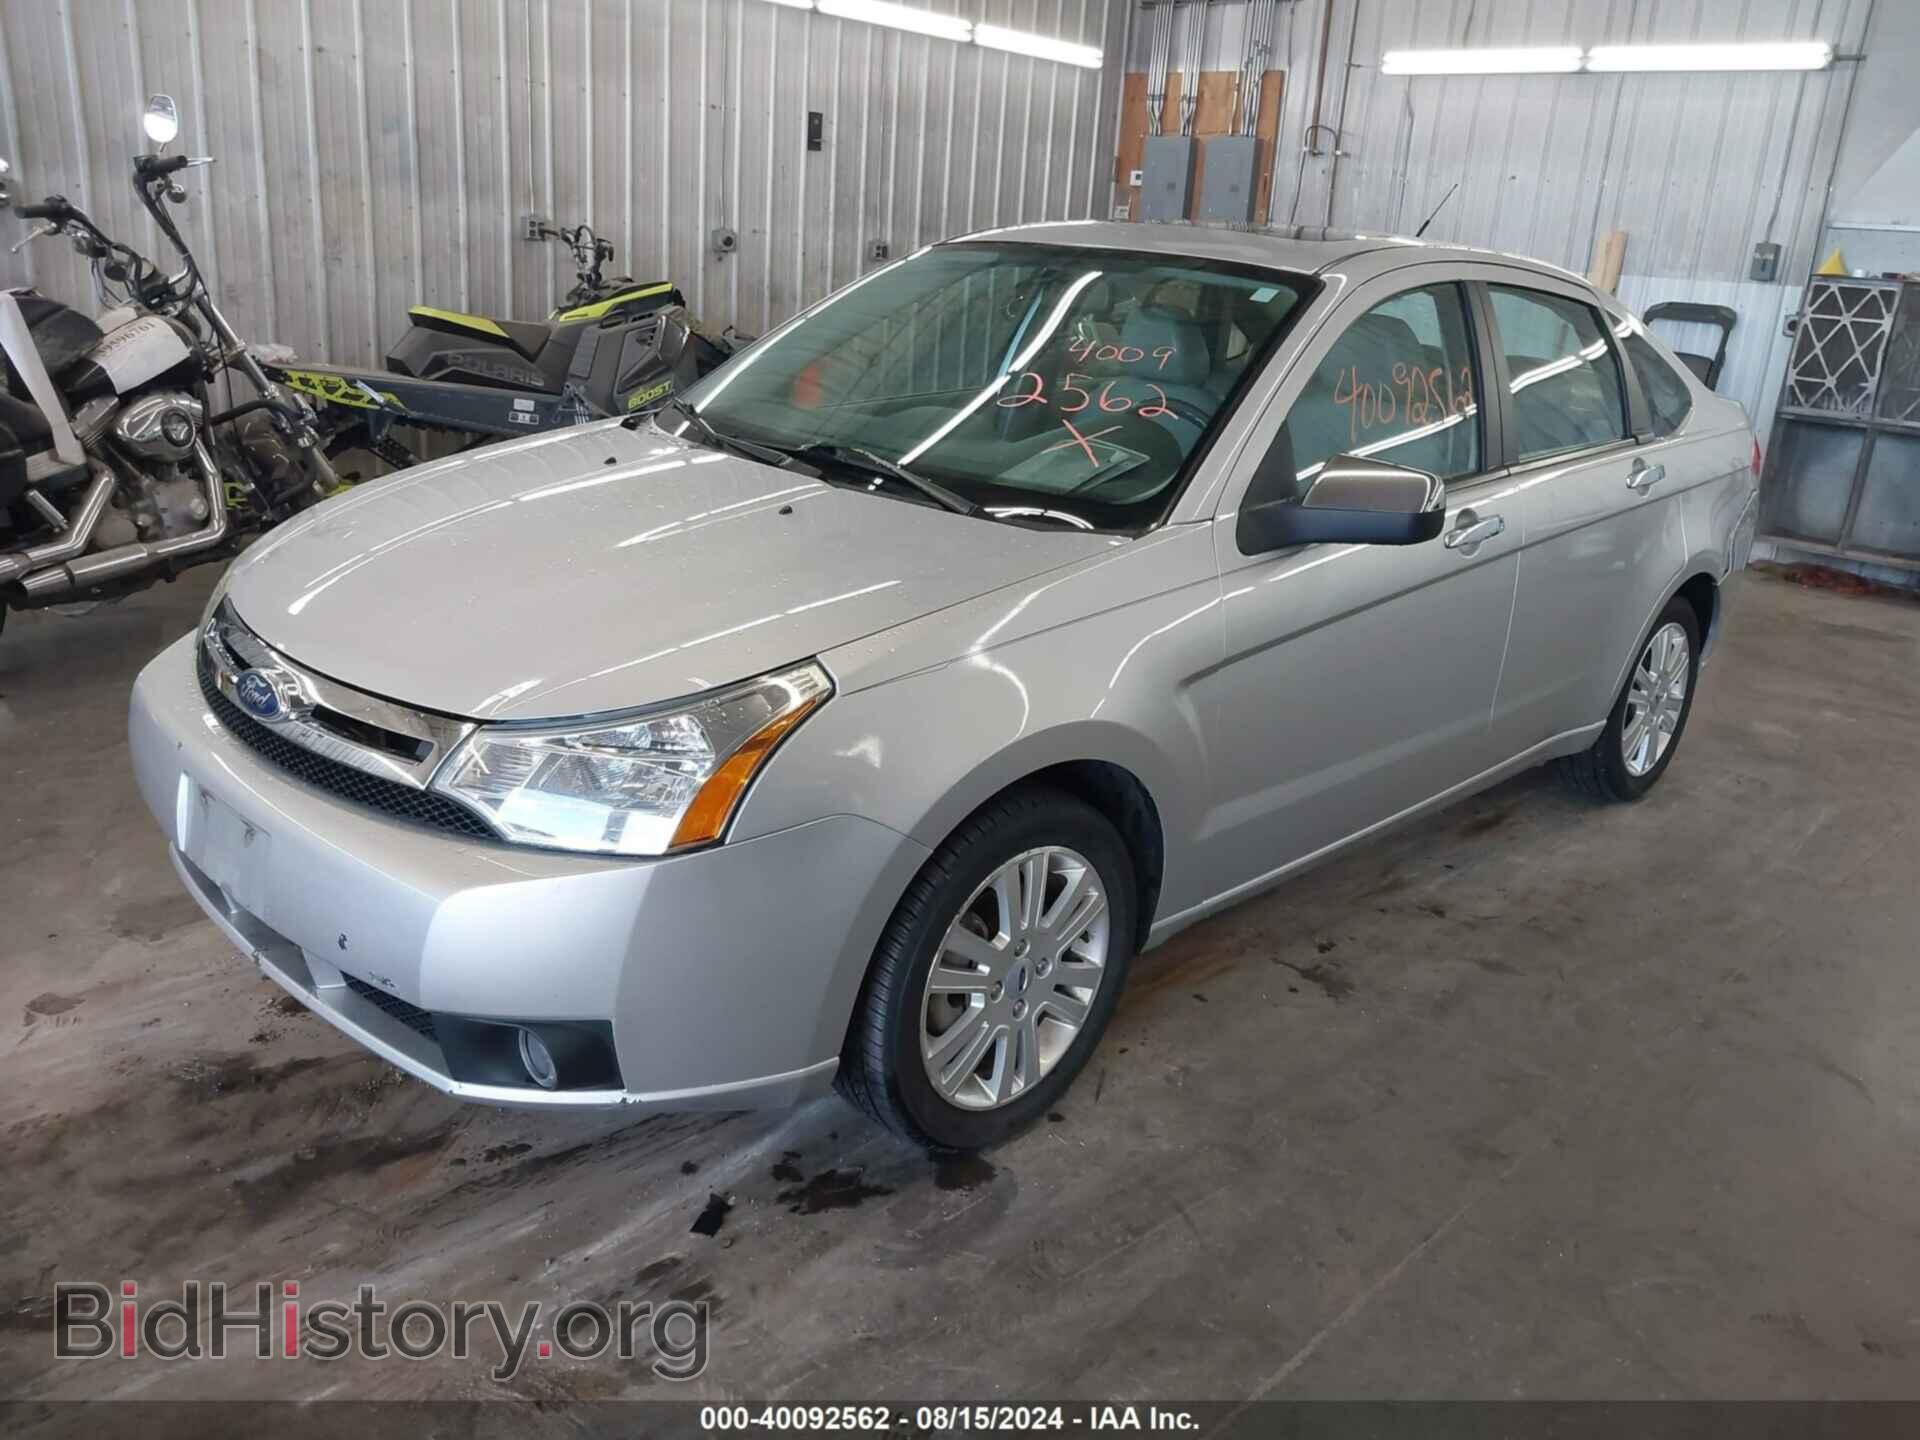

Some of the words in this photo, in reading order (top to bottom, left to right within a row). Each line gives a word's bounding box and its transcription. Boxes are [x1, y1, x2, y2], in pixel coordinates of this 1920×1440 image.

[447, 353, 545, 386] POLARIS
[1069, 336, 1177, 370] 4009
[627, 380, 673, 411] BOOST
[996, 372, 1179, 419] 2562
